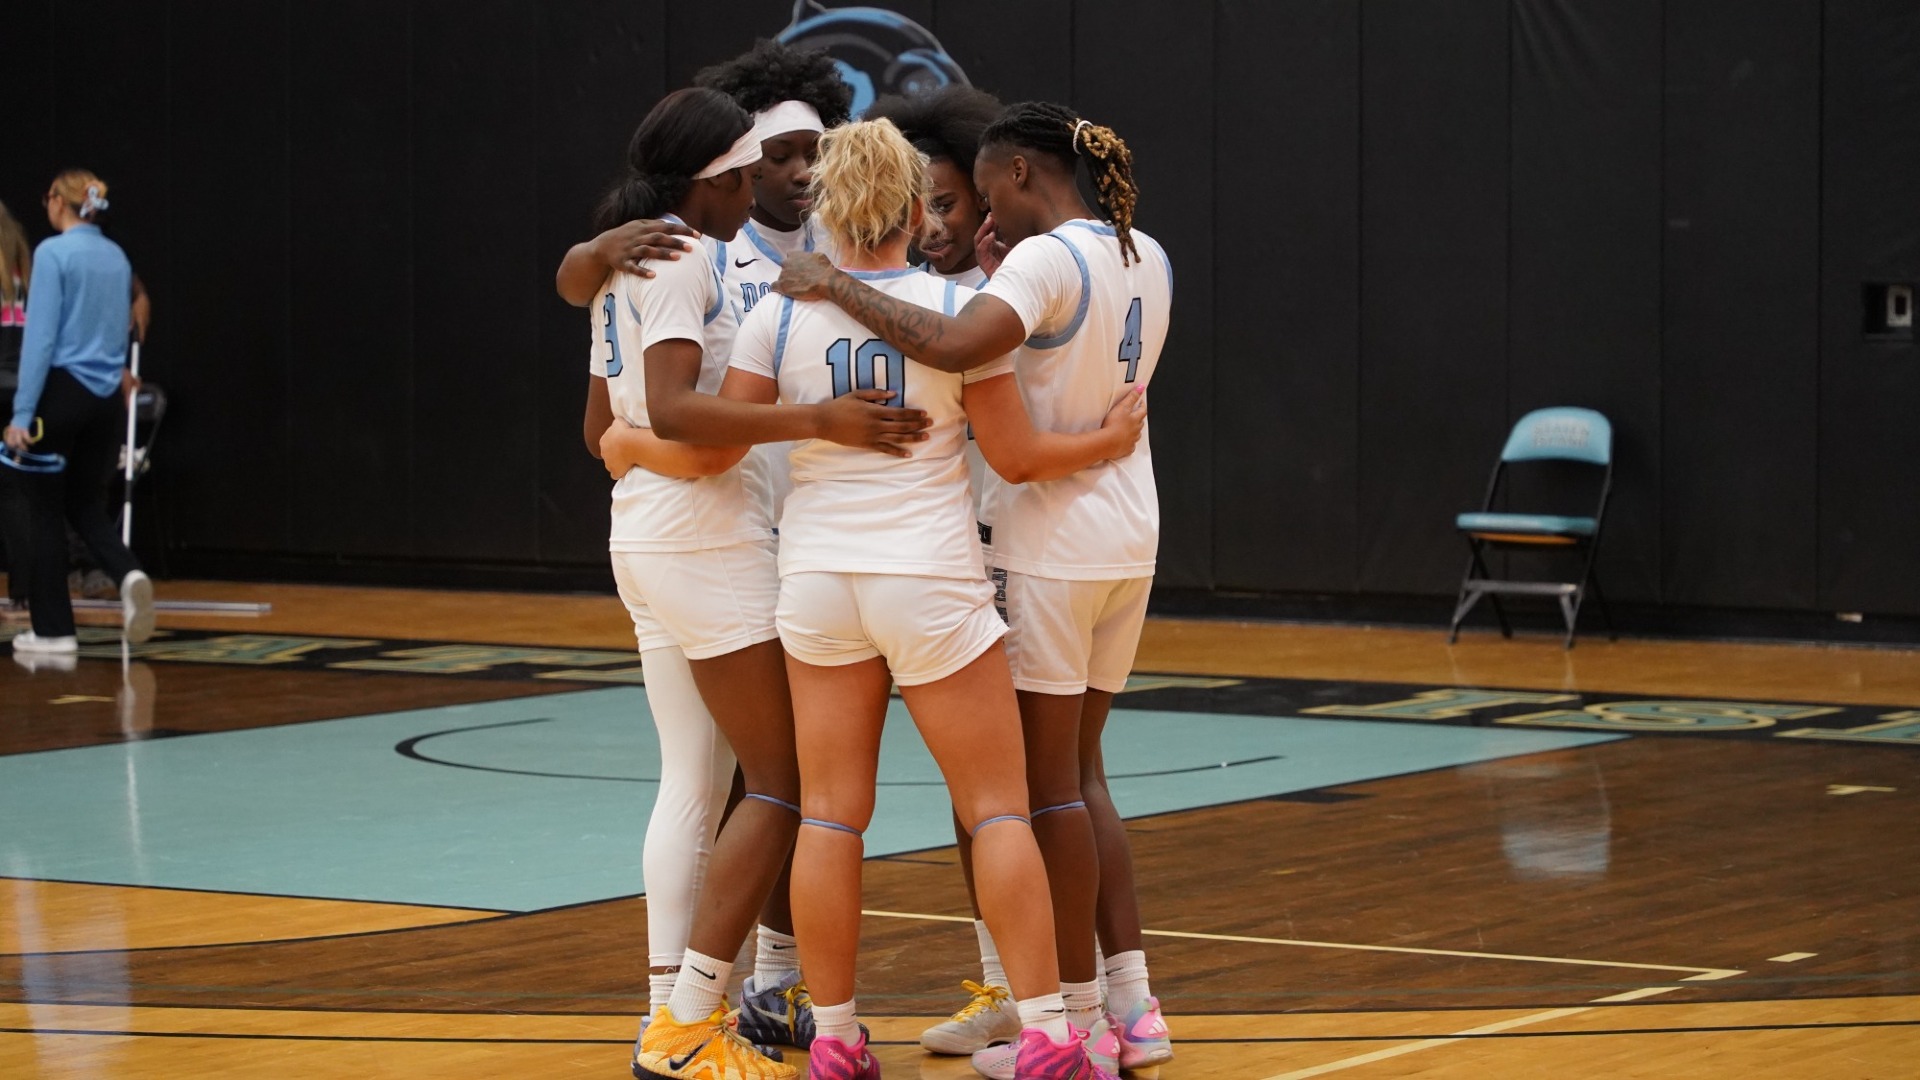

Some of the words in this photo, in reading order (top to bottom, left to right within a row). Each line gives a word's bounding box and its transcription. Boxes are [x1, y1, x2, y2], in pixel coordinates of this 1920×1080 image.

[740, 282, 771, 313] DO
[826, 338, 905, 409] 10
[1118, 297, 1142, 384] 4
